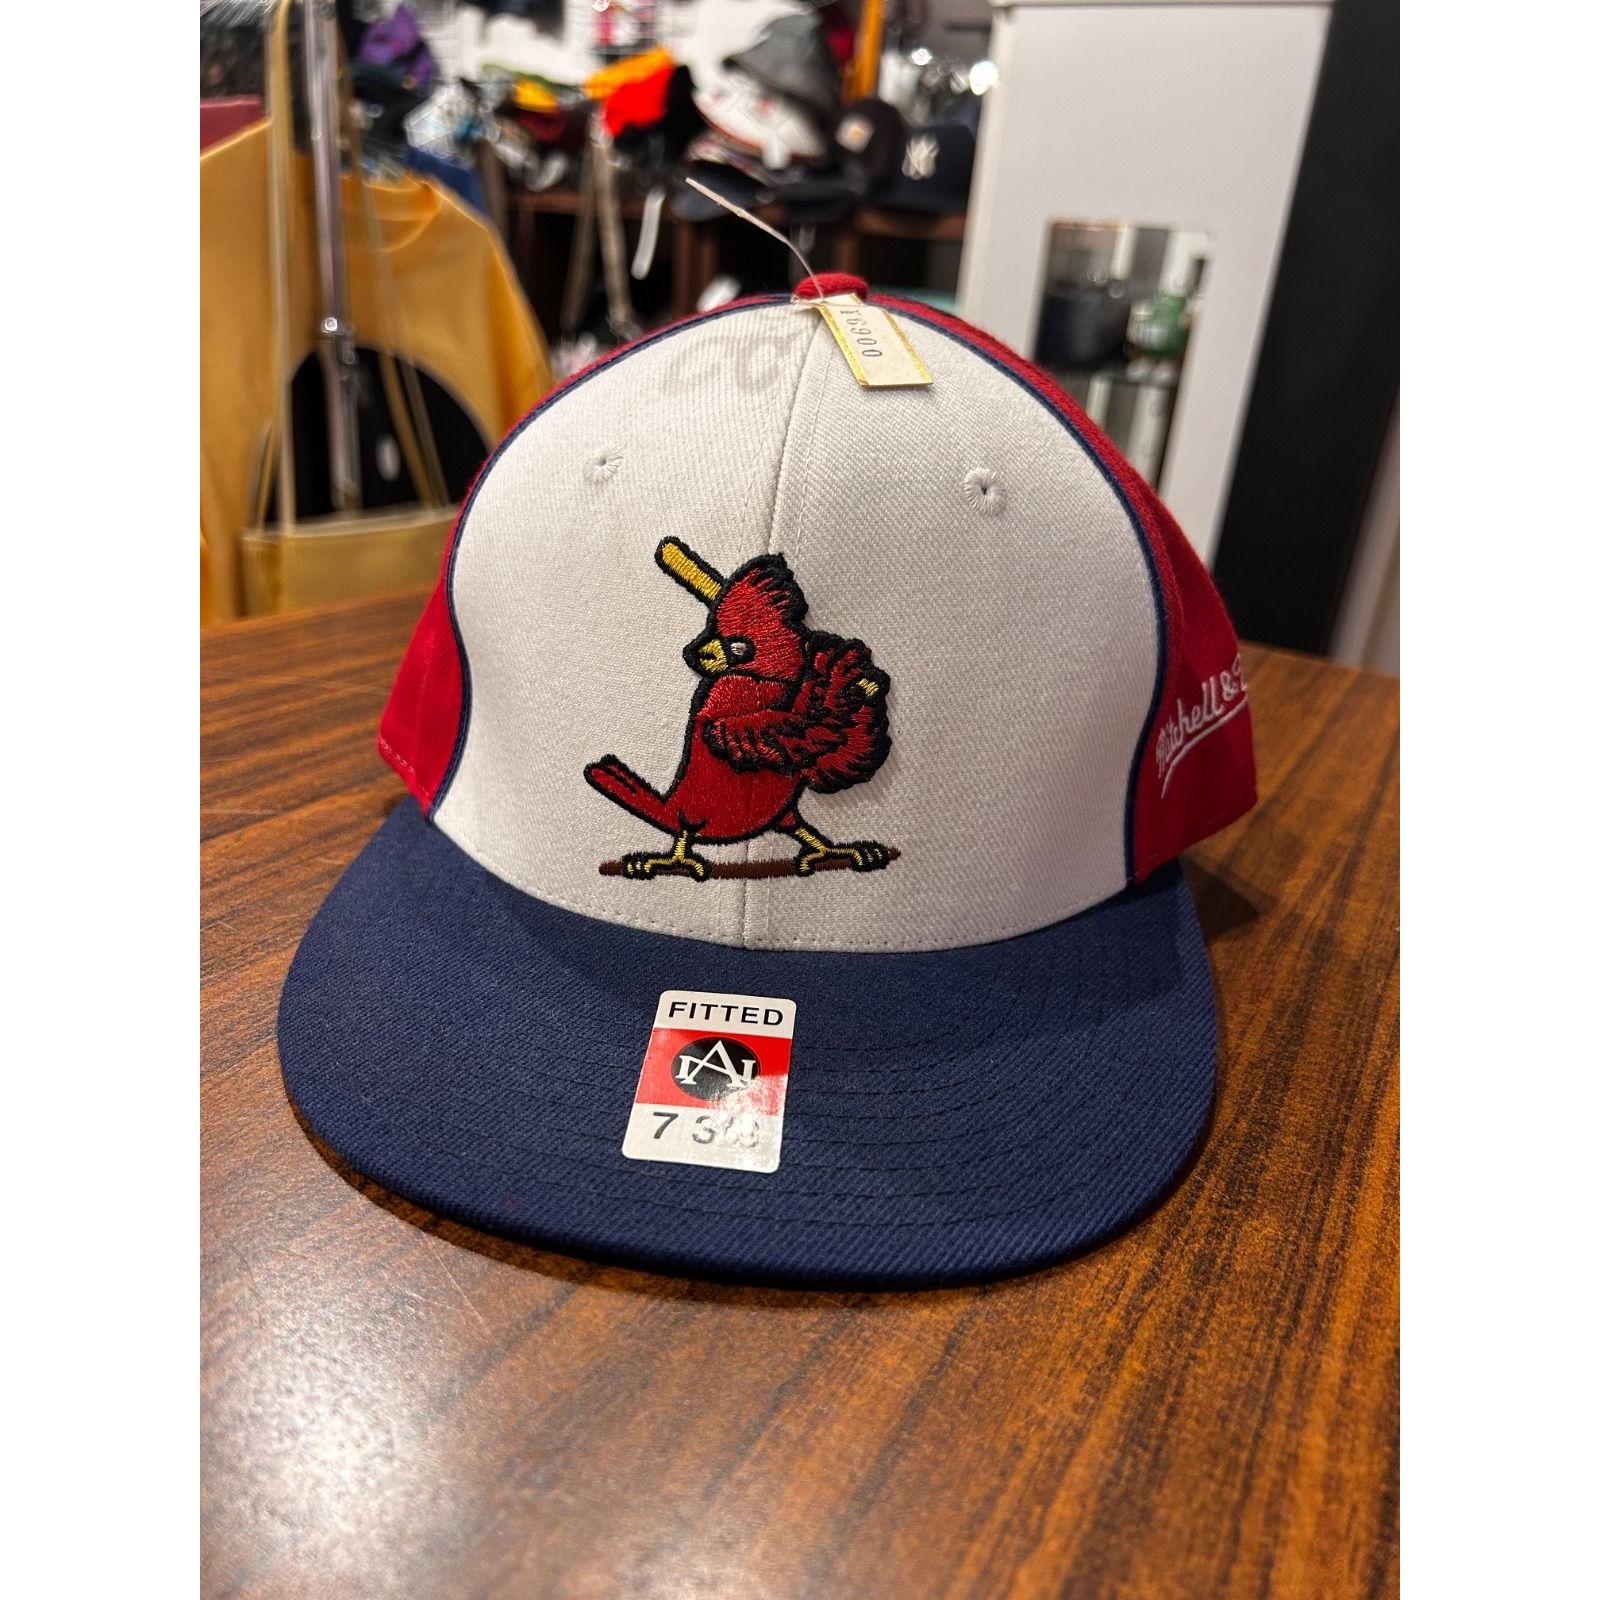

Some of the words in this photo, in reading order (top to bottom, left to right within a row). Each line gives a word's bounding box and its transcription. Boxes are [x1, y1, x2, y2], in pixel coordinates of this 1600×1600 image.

[1155, 675, 1225, 779] Mitchell
[668, 1001, 784, 1026] FITTED
[652, 1111, 679, 1140] 7
